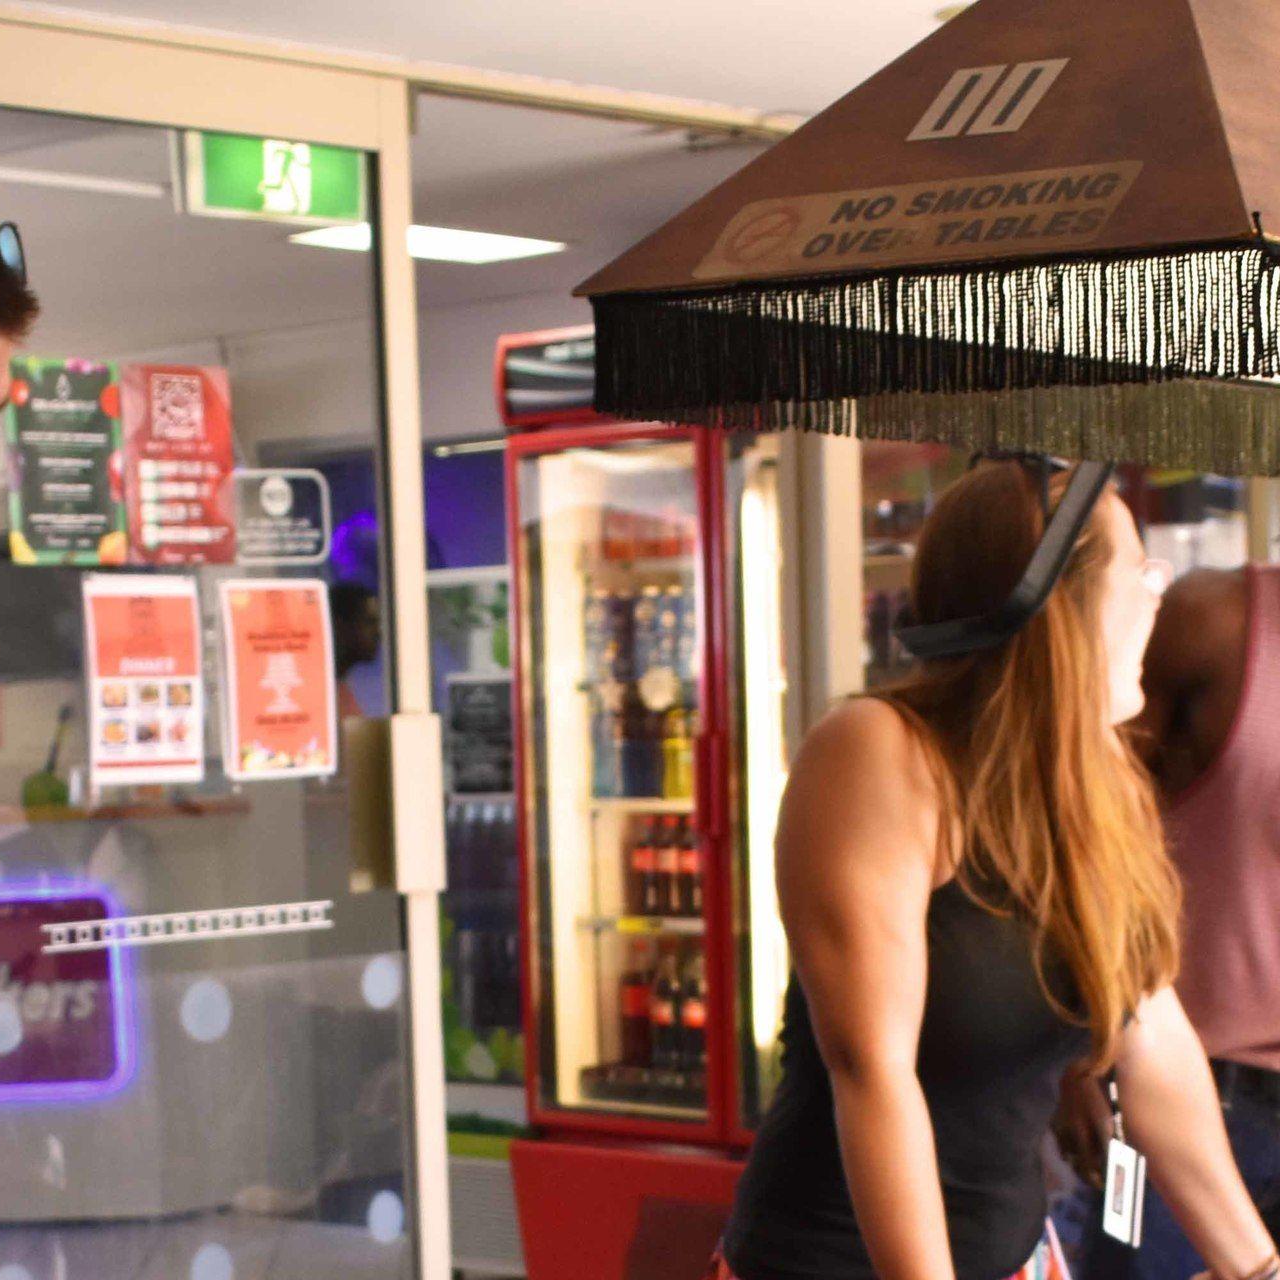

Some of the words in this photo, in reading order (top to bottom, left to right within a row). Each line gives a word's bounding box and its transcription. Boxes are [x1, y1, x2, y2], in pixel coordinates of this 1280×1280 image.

[828, 194, 898, 225] NO
[905, 173, 1119, 215] SMOKING
[935, 208, 1105, 245] TABLES
